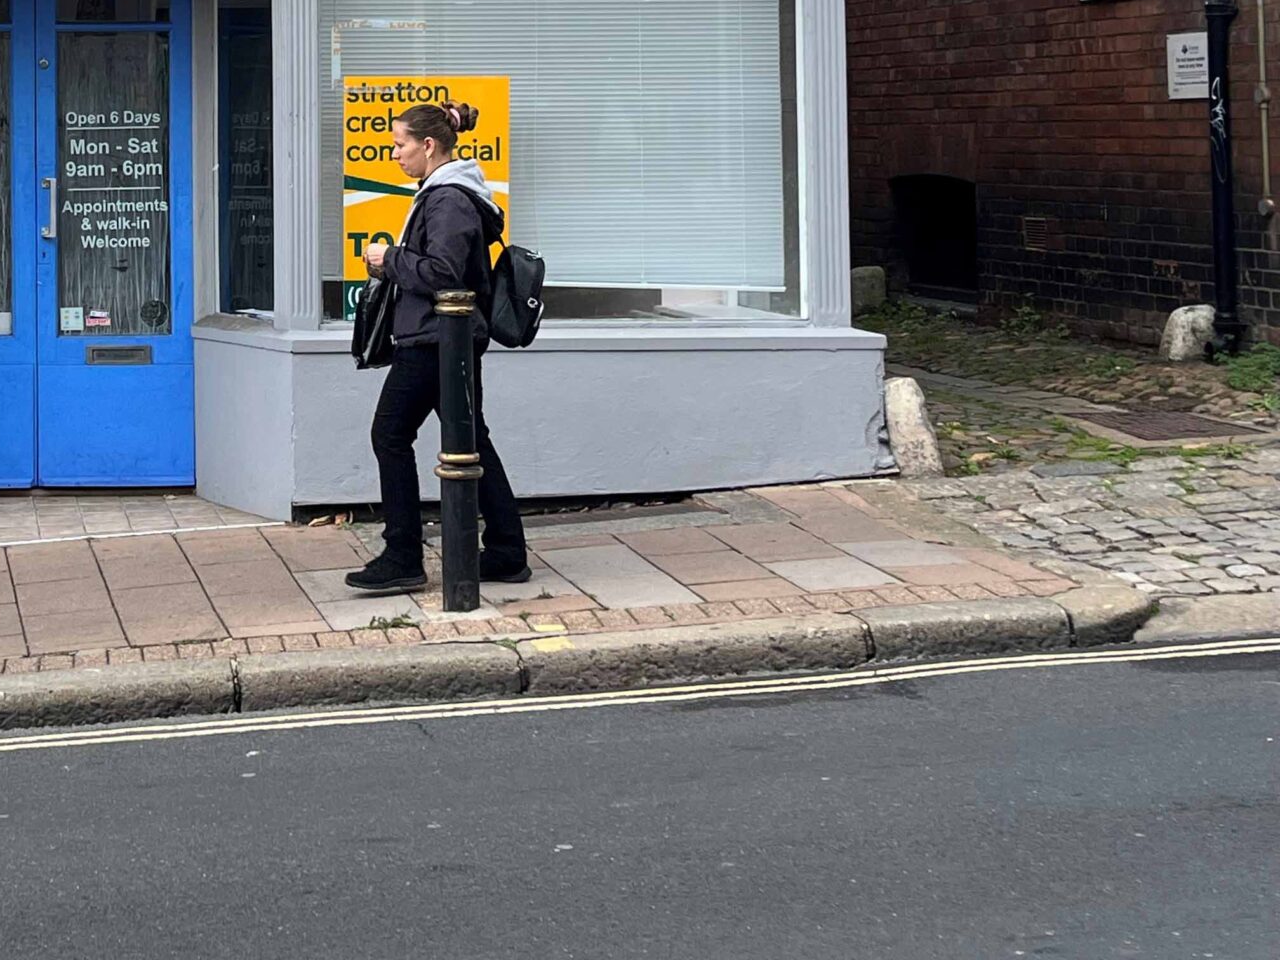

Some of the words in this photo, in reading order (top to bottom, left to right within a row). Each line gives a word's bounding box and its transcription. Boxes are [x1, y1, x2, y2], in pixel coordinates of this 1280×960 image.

[346, 82, 449, 103] stratton
[65, 111, 106, 127] Open
[110, 111, 119, 124] 6
[123, 110, 161, 126] Days
[70, 139, 110, 155] Mon
[127, 137, 159, 154] Sat
[65, 161, 105, 177] 9am
[122, 160, 163, 180] 6pm
[61, 199, 168, 216] Appointments
[81, 217, 92, 231] &
[96, 216, 150, 230] walk-in
[80, 235, 151, 249] Welcome
